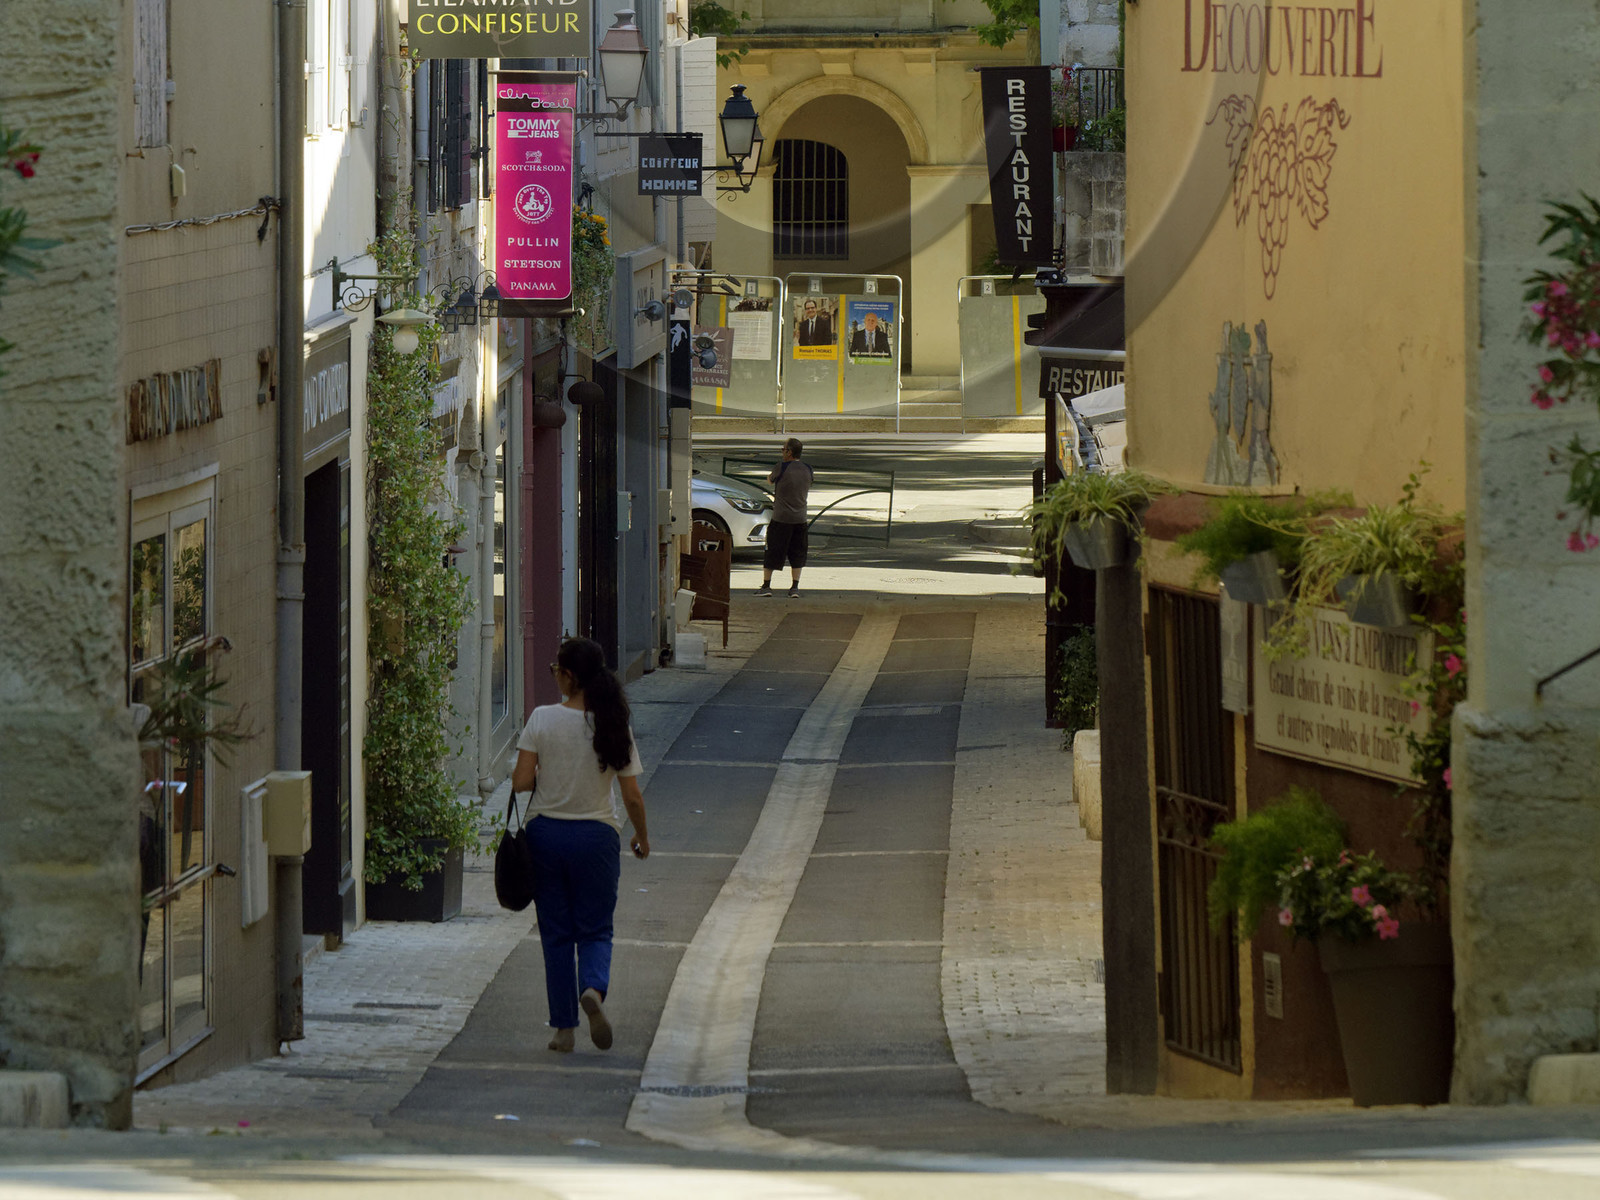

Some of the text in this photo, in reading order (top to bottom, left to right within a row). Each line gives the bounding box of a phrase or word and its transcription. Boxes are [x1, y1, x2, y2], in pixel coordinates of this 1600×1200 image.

[416, 12, 580, 35] CONFISEUR
[507, 119, 561, 130] TOMMY
[528, 131, 560, 139] JEANS
[501, 164, 566, 172] SCOTCH&SODA
[1007, 79, 1033, 252] RESTAURANT
[641, 179, 698, 190] HOMME
[507, 237, 559, 246] PULLIN
[504, 259, 561, 269] STETSON
[510, 282, 557, 290] PANAMA
[1298, 666, 1321, 704] choix
[1324, 673, 1334, 706] de
[1337, 676, 1356, 711] vins
[1359, 680, 1369, 714] de
[1371, 682, 1380, 717] la
[1317, 714, 1358, 755] vignobles
[1360, 722, 1370, 757] de
